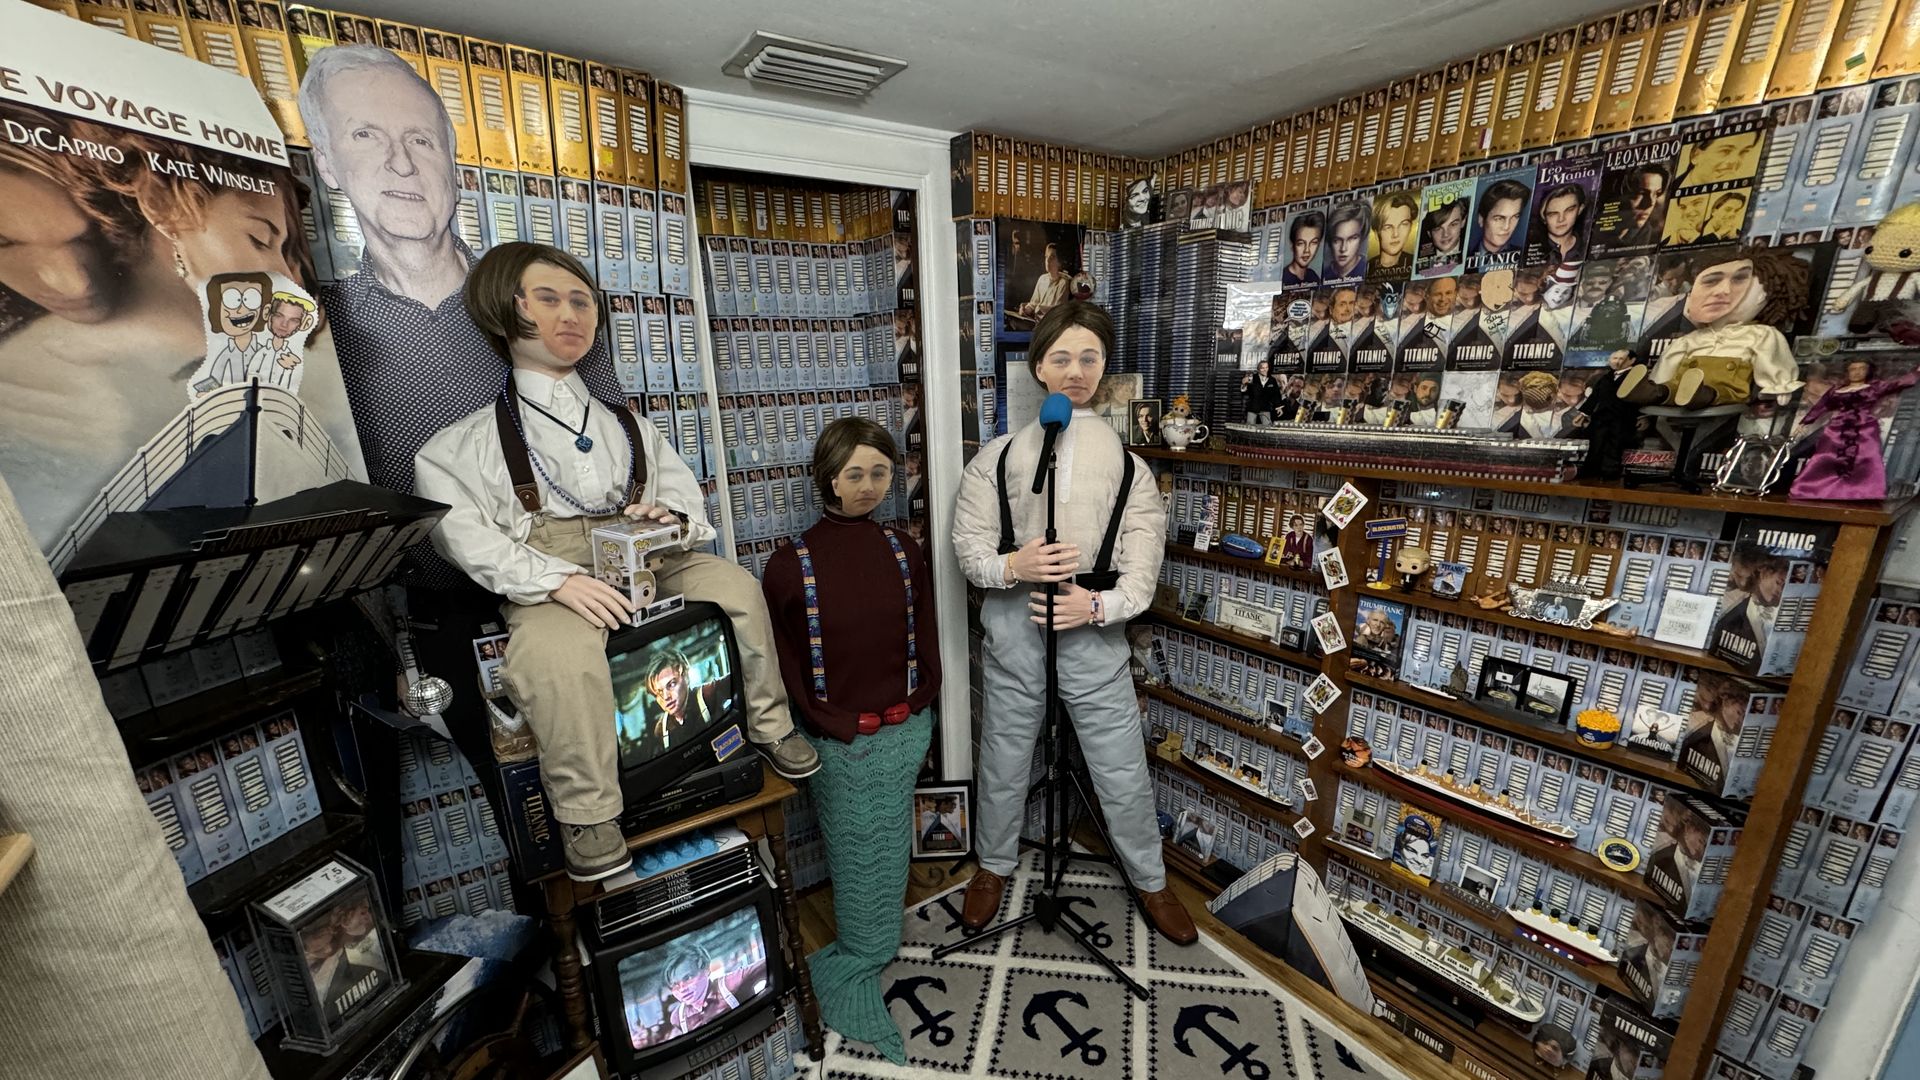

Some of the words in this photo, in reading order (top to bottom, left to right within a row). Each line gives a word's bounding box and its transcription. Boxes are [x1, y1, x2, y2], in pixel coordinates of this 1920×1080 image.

[1610, 37, 1644, 97] TITANIC
[1651, 26, 1689, 87] TITANIC
[1502, 69, 1530, 121] TITANIC
[1571, 49, 1603, 105] TITANIC
[36, 76, 190, 136] VOYAGE
[199, 119, 284, 160] HOME
[559, 88, 583, 144] TITANIC
[1412, 97, 1435, 144] TITANIC
[1441, 87, 1465, 135] TITANIC
[1471, 77, 1496, 127] TITANIC
[597, 95, 618, 148] TITANIC
[629, 104, 648, 155] TITANIC
[664, 112, 681, 161] TITANIC
[1360, 112, 1380, 157] TITANIC
[1386, 104, 1407, 149] TITANIC
[1271, 141, 1287, 180] TITANIC
[1292, 133, 1308, 174] TITANIC
[1313, 127, 1331, 169] TITANIC
[1336, 120, 1354, 163] TITANIC
[1606, 140, 1681, 168] LEONARDO
[1804, 122, 1851, 187] TITANIC
[1858, 113, 1909, 180] TITANIC
[146, 150, 199, 181] KATE
[201, 163, 276, 197] WINSLET
[977, 155, 989, 193] TITANIC
[997, 159, 1008, 196] TITANIC
[1016, 161, 1027, 197] TITANIC
[1033, 164, 1043, 199] TITANIC
[1551, 168, 1596, 186] Mania
[567, 208, 590, 258] TITANIC
[602, 211, 624, 260] TITANIC
[634, 215, 653, 263] TITANIC
[666, 219, 685, 265] TITANIC
[713, 256, 730, 292] TITANIC
[734, 256, 751, 293] TITANIC
[756, 258, 772, 294] TITANIC
[776, 259, 792, 294] TITANIC
[852, 258, 865, 292] TITANIC
[977, 239, 989, 276] TITANIC
[1466, 251, 1521, 269] TITANIC
[796, 260, 812, 295] TITANIC
[815, 261, 831, 296] TITANIC
[834, 261, 849, 296] TITANIC
[616, 319, 638, 364] TITANIC
[647, 319, 668, 364] TITANIC
[678, 320, 697, 364] TITANIC
[757, 335, 773, 369] TITANIC
[815, 335, 831, 368] TITANIC
[980, 318, 992, 353] TITANIC
[1456, 344, 1494, 361] TITANIC
[1512, 342, 1556, 360] TITANIC
[1313, 350, 1341, 365] TITANIC
[1357, 349, 1387, 364] TITANIC
[1404, 347, 1438, 363] TITANIC
[983, 392, 994, 425] TITANIC
[682, 415, 698, 455] TITANIC
[1225, 501, 1238, 531] TITANIC
[1243, 504, 1255, 535] TITANIC
[1501, 492, 1549, 514] TITANIC
[1618, 503, 1680, 528] TITANIC
[1262, 507, 1275, 538] TITANIC
[1372, 524, 1405, 533] BLOCKBUSTER
[1756, 529, 1816, 551] TITANIC
[1485, 539, 1509, 578] TITANIC
[1516, 543, 1541, 584] TITANIC
[65, 516, 439, 671] TITANIC
[1620, 557, 1653, 604] TITANIC
[1775, 597, 1800, 632] TITANIC
[1412, 625, 1433, 662] TITANIC
[1439, 632, 1461, 669] TITANIC
[1719, 630, 1757, 658] TITANIC
[1861, 629, 1911, 680] TITANIC
[1373, 716, 1392, 750] TITANIC
[1398, 723, 1417, 760] TITANIC
[1424, 732, 1443, 769] TITANIC
[274, 737, 308, 794] TITANIC
[1451, 742, 1470, 779] TITANIC
[1478, 752, 1499, 790] TITANIC
[1687, 747, 1721, 781] TITANIC
[1846, 740, 1894, 789] TITANIC
[234, 754, 272, 813] TITANIC
[1508, 761, 1531, 801] TITANIC
[1537, 772, 1564, 813] TITANIC
[190, 773, 231, 834] TITANIC
[526, 791, 550, 844] TITANIC
[1570, 783, 1599, 825] TITANIC
[1604, 796, 1635, 838] TITANIC
[1817, 839, 1861, 886] TITANIC
[1862, 854, 1892, 888] TITANIC
[1518, 863, 1541, 901] TITANIC
[1549, 876, 1572, 914] TITANIC
[1652, 864, 1684, 902] TITANIC
[1754, 915, 1793, 960] TITANIC
[1800, 934, 1841, 979] TITANIC
[335, 970, 379, 1015] TITANIC
[1625, 961, 1652, 999] TITANIC
[1615, 1015, 1657, 1048] TITANIC
[1727, 995, 1762, 1036] TITANIC
[1414, 1027, 1444, 1054] TITANIC
[1768, 1016, 1806, 1058] TITANIC
